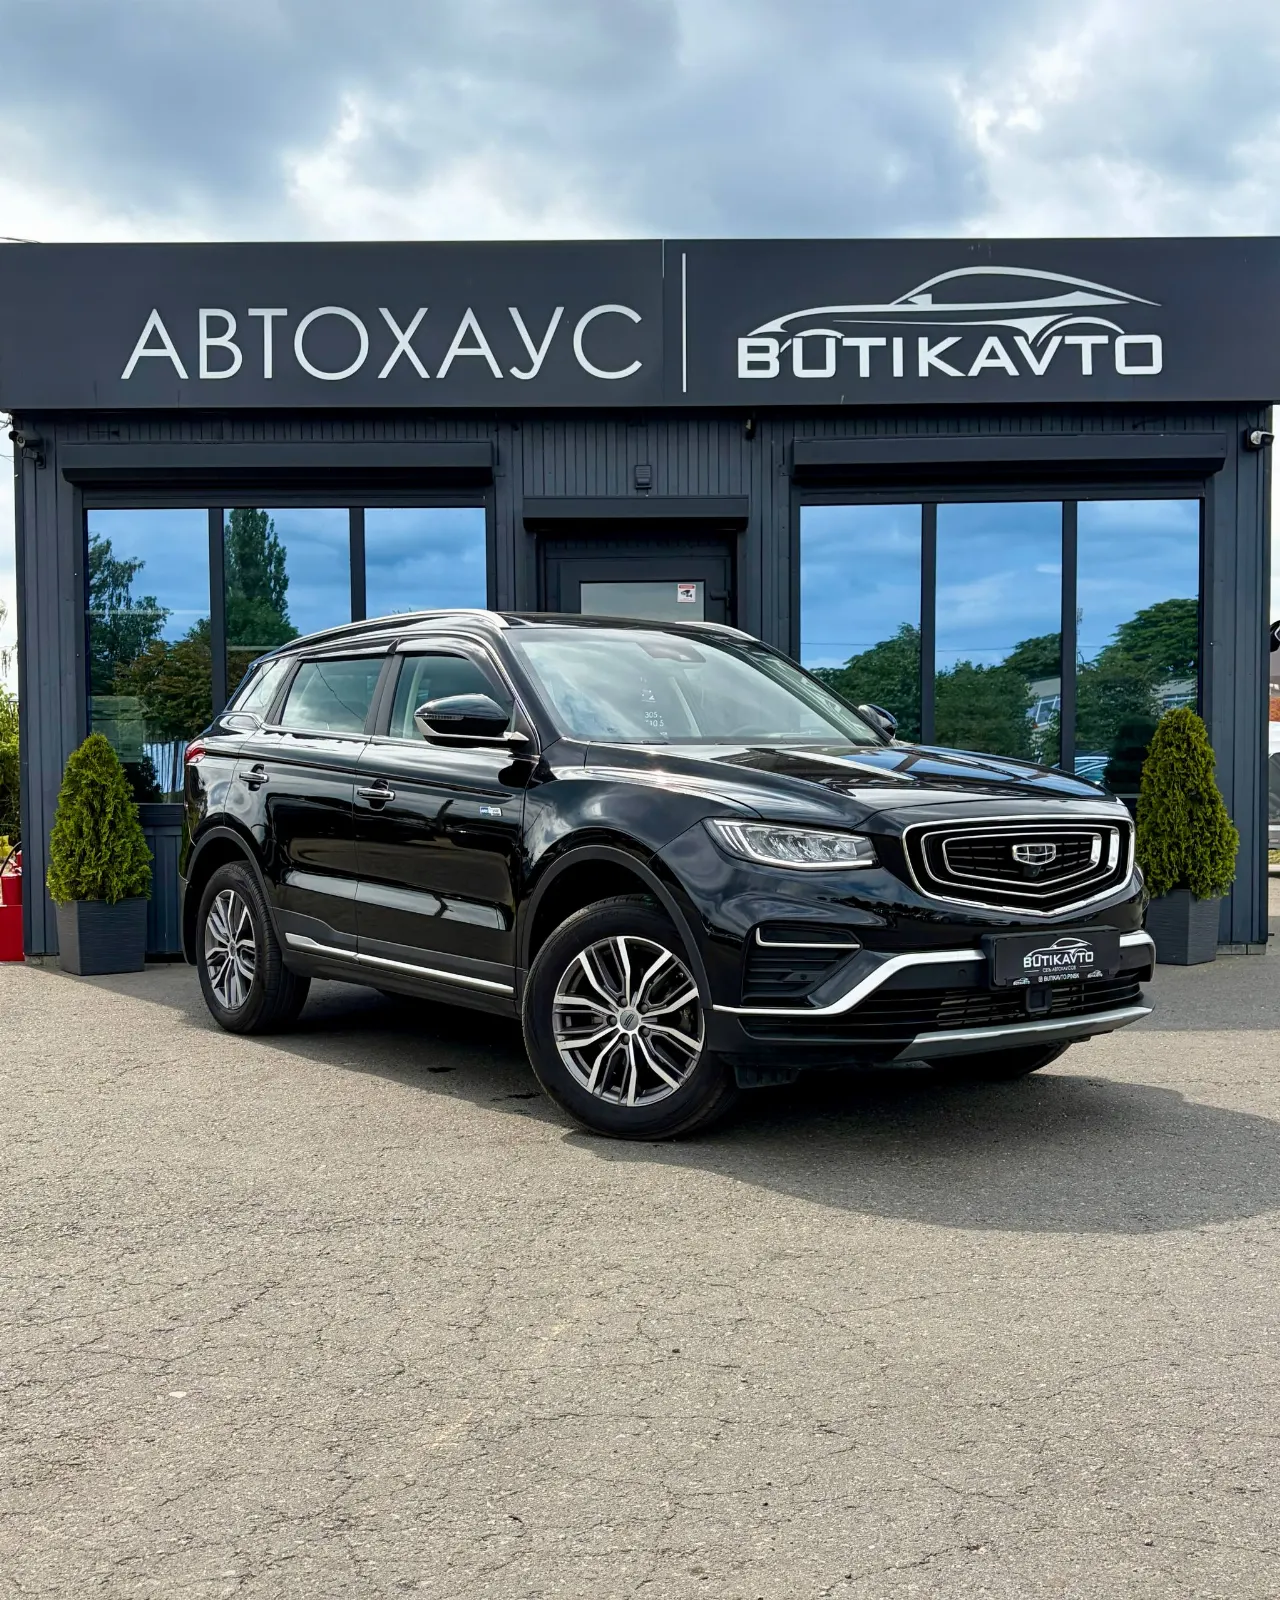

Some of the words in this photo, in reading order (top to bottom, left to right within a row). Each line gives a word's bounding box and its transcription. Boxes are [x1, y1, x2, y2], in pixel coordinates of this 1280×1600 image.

[120, 304, 643, 381] АВТОХАУС
[737, 333, 1163, 379] BUTIKAVTO
[1023, 951, 1094, 968] BUTIKAVTO
